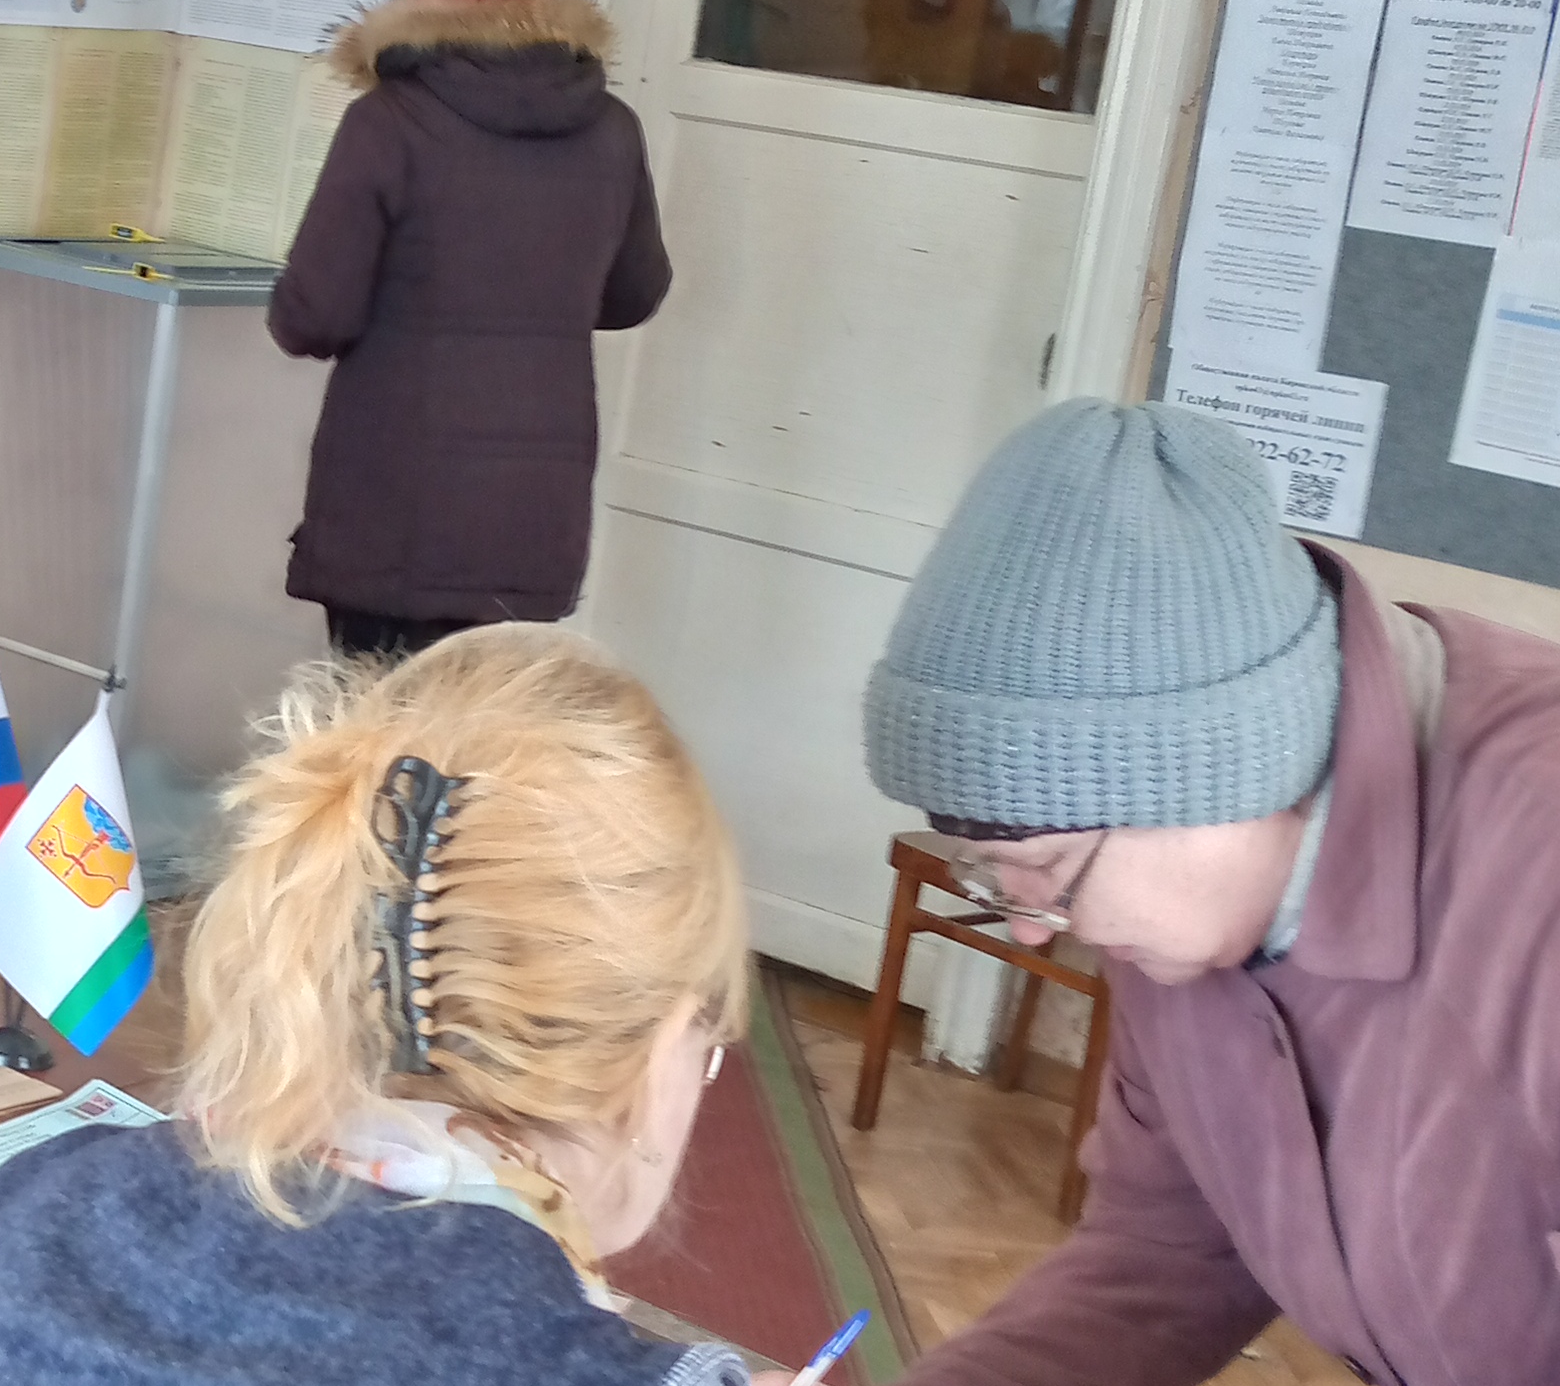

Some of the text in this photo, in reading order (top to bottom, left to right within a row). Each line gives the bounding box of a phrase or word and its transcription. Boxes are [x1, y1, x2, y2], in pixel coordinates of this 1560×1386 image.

[1176, 388, 1240, 412] Телефон
[1245, 403, 1308, 424] горячей
[1311, 415, 1365, 433] линии
